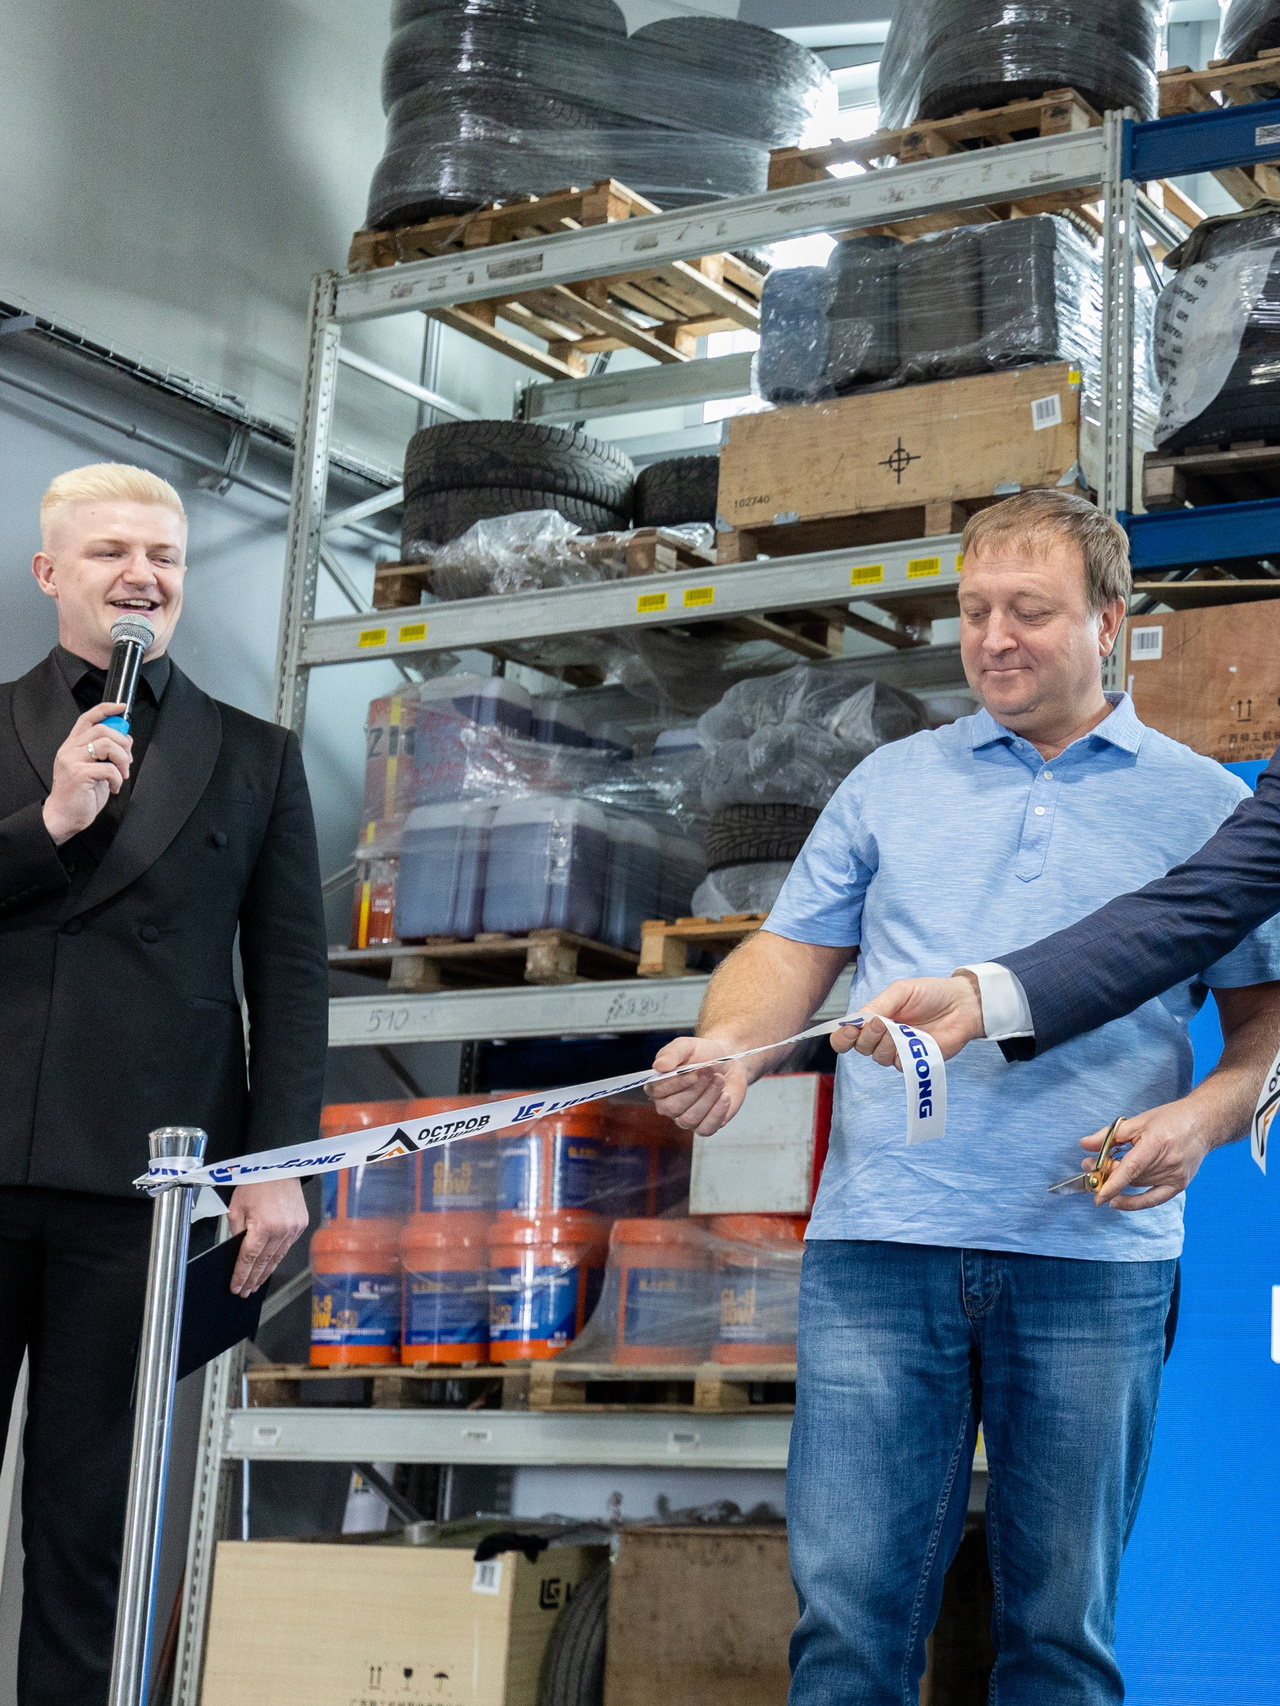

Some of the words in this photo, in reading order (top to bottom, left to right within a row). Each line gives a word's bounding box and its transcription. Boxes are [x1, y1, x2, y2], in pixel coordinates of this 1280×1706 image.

[734, 495, 771, 508] 102740
[897, 1021, 933, 1120] UGONG
[417, 1114, 491, 1141] ОСТРОВ
